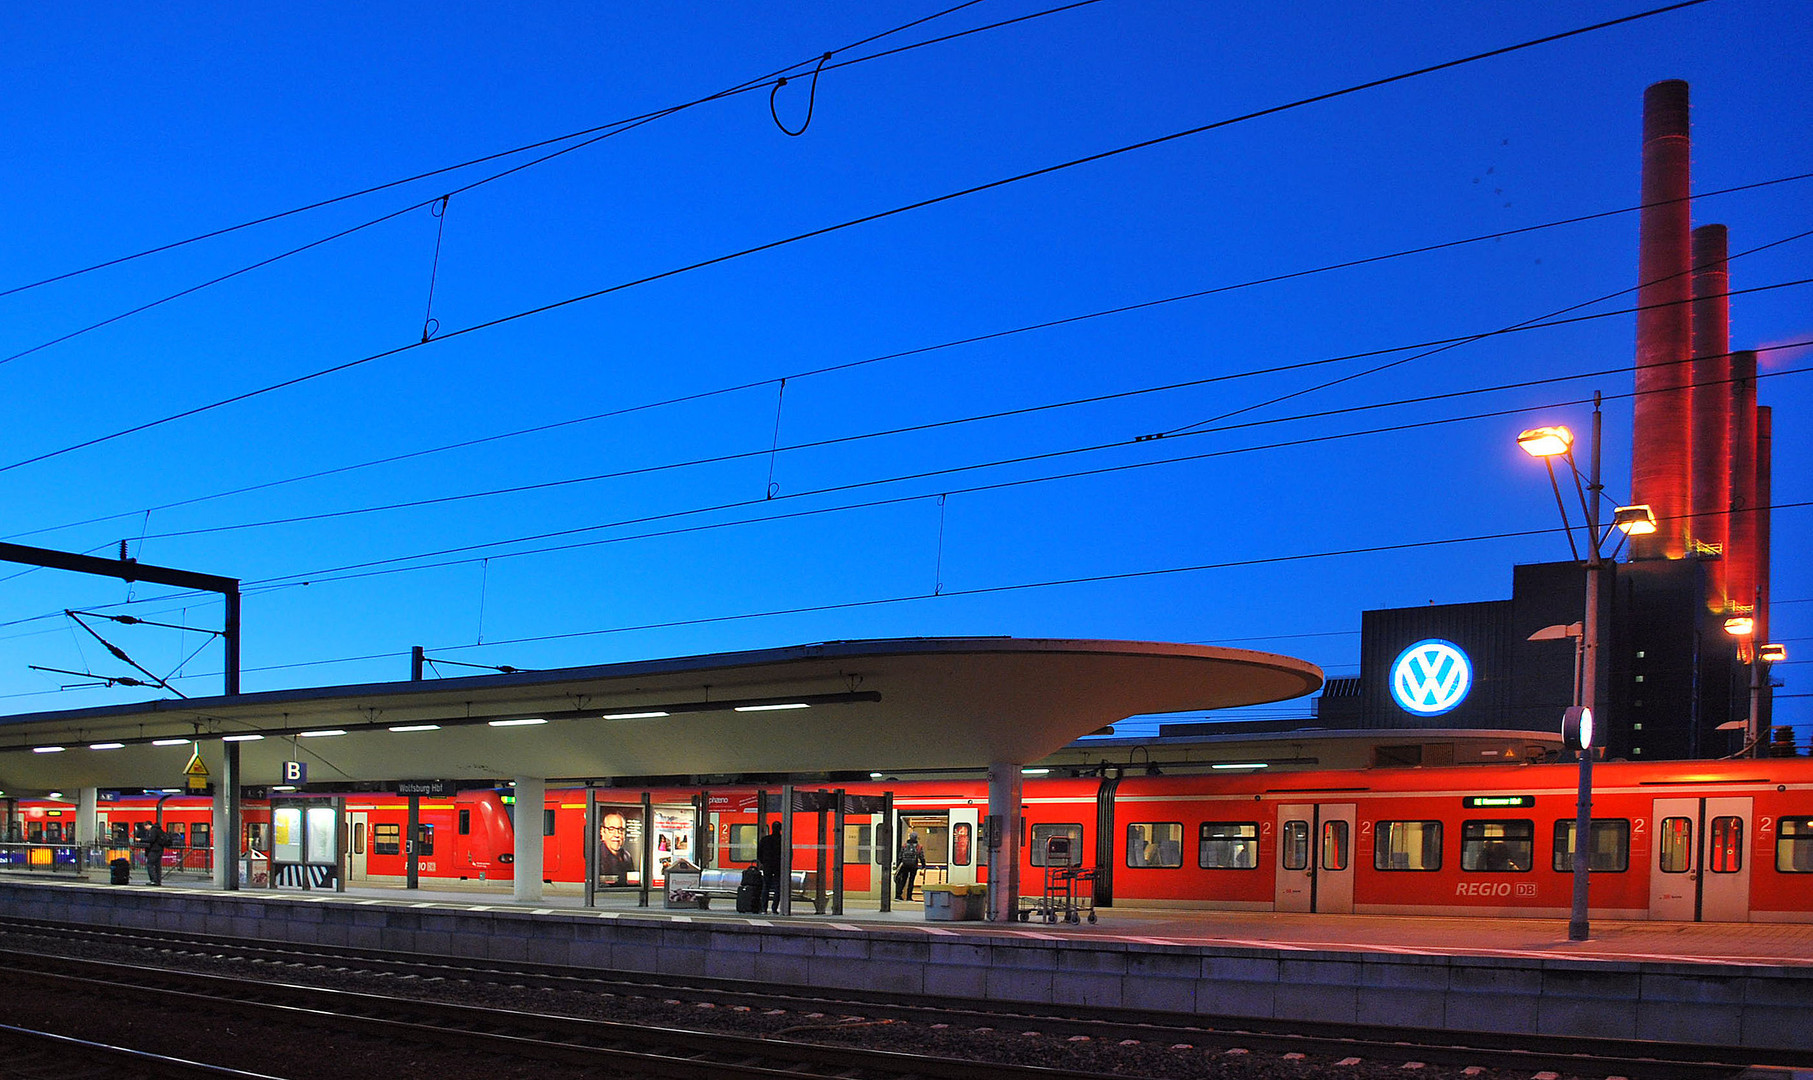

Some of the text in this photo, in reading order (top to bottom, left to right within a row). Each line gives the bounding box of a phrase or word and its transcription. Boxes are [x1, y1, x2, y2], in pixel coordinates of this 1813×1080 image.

[1393, 642, 1470, 713] VW
[287, 762, 301, 780] B
[399, 784, 443, 794] Wolfsburg Hbf
[722, 823, 729, 835] 2
[1262, 821, 1272, 835] 2
[1361, 821, 1371, 834] 2
[1634, 818, 1645, 833] 2
[1760, 817, 1772, 832] 2
[1455, 882, 1537, 897] REGIO DB
